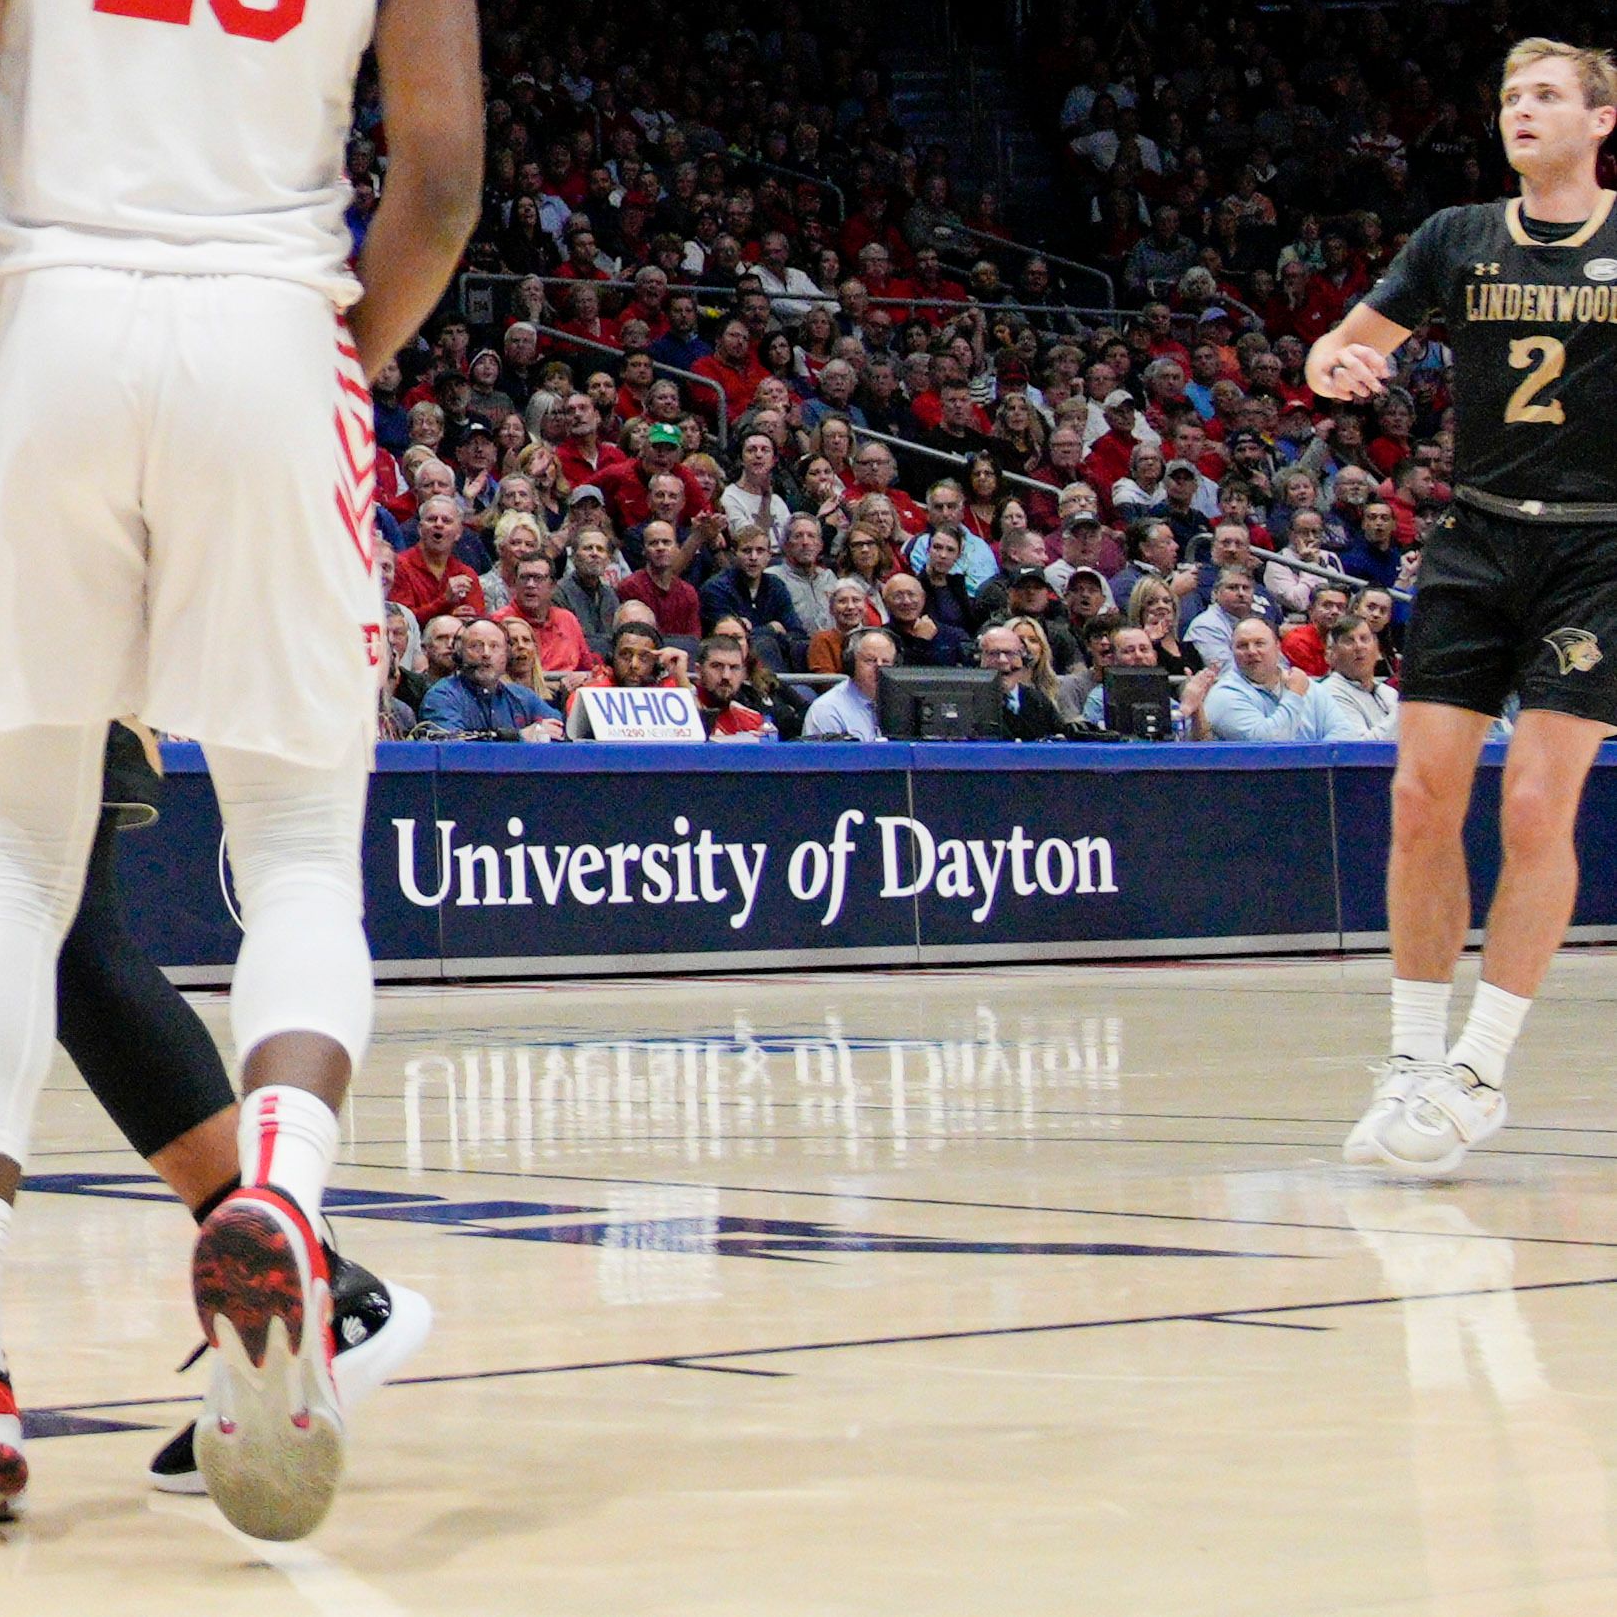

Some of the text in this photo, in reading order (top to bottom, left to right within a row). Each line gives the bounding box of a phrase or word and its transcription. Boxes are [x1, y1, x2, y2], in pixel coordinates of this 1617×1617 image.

[1503, 335, 1567, 425] 2
[591, 691, 689, 726] WHIO
[392, 808, 1119, 930] University of Dayton
